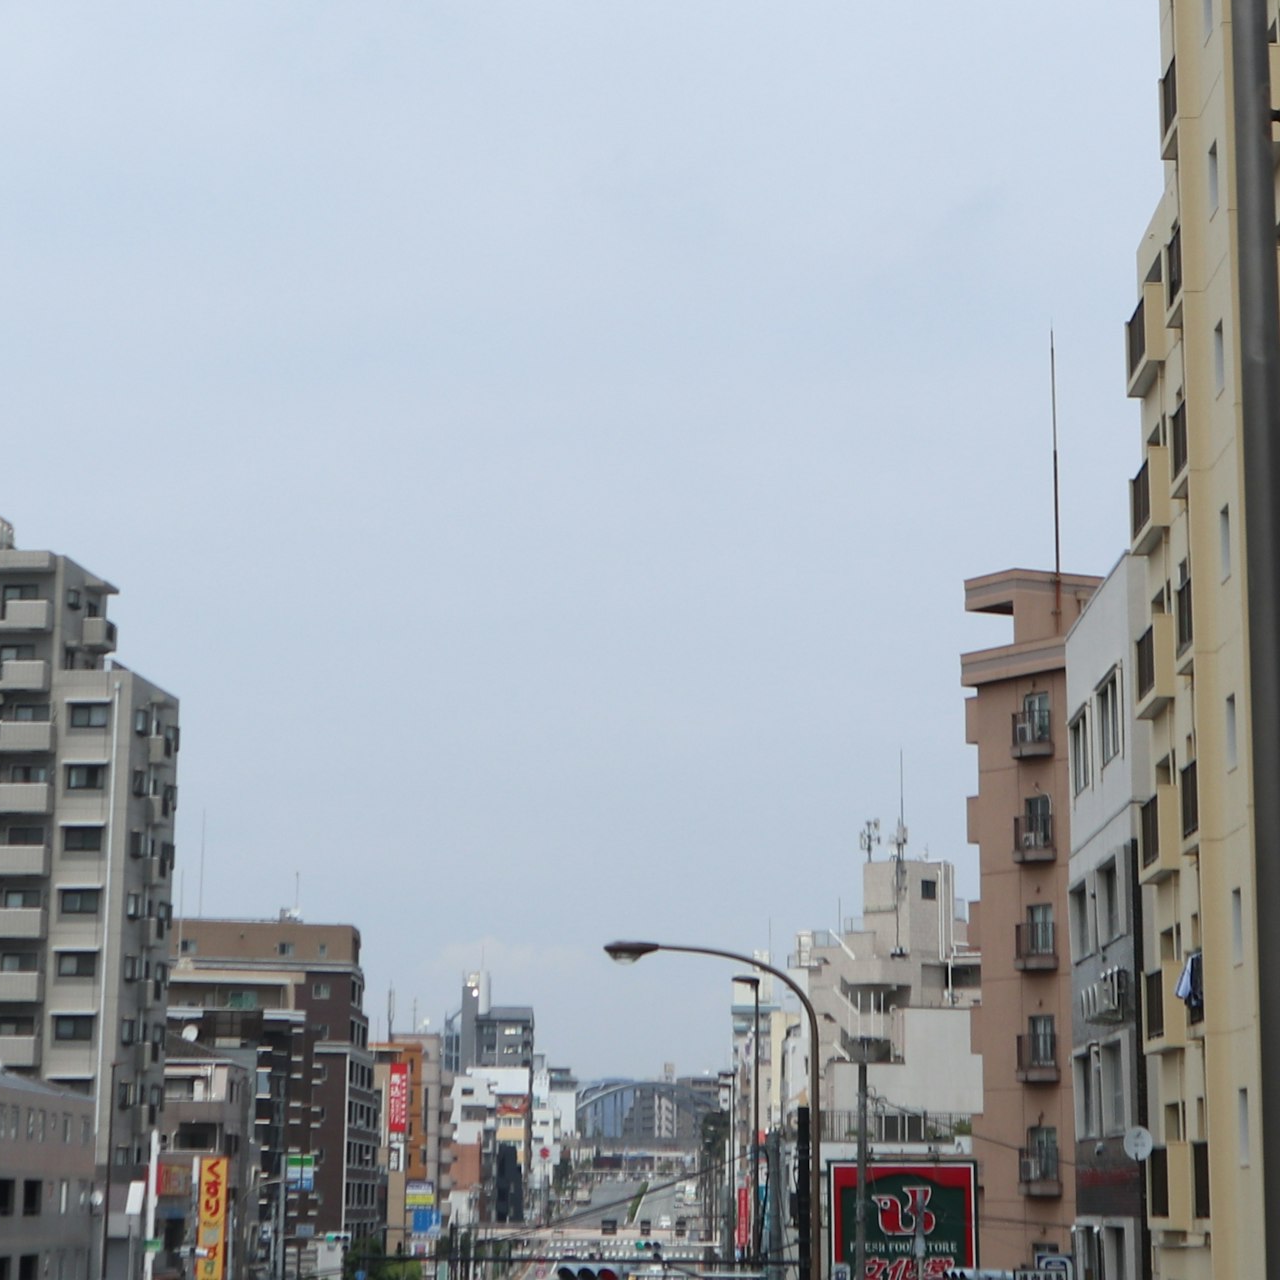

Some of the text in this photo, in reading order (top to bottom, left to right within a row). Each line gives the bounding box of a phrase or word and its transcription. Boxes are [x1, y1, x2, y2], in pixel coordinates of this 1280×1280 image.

[204, 1160, 222, 1218] くすり
[849, 1241, 886, 1254] FESH
